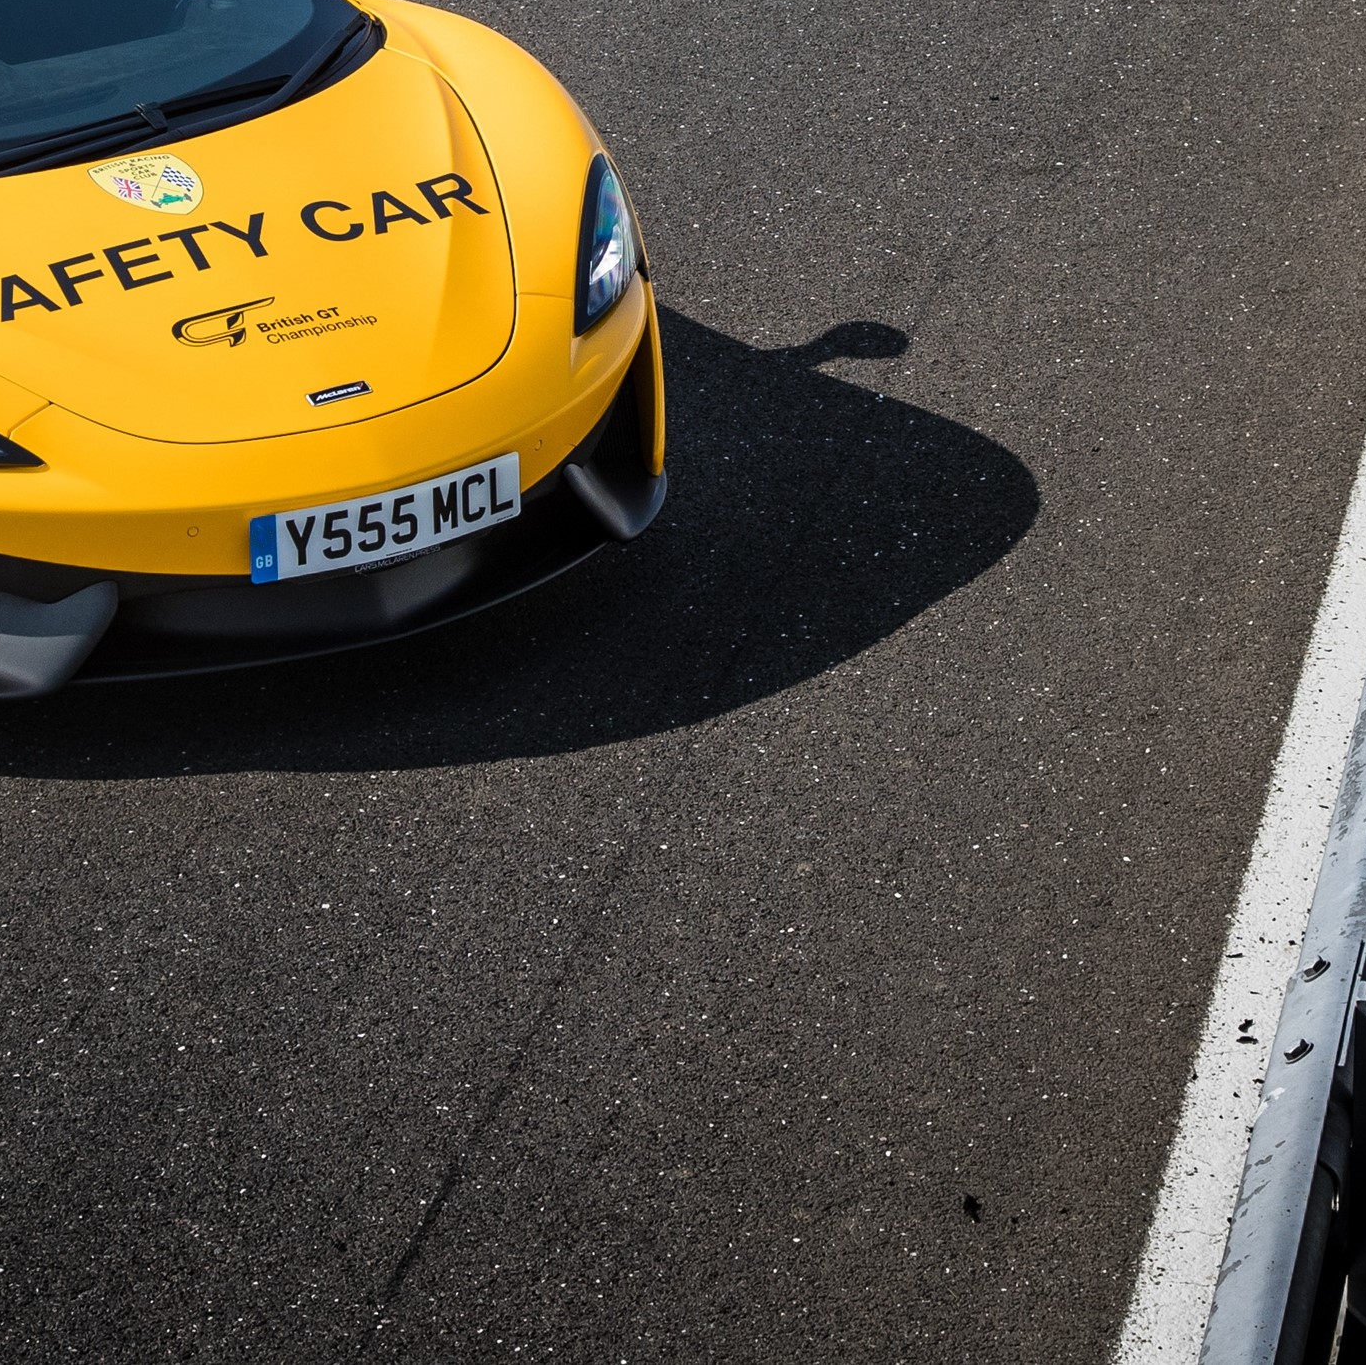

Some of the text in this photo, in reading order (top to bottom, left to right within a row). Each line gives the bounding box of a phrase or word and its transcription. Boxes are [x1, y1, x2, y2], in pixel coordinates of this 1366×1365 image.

[301, 172, 490, 241] CAR
[256, 306, 341, 333] British GT
[266, 313, 378, 345] Championship
[285, 466, 514, 567] Y555 MCL
[255, 554, 273, 569] GB
